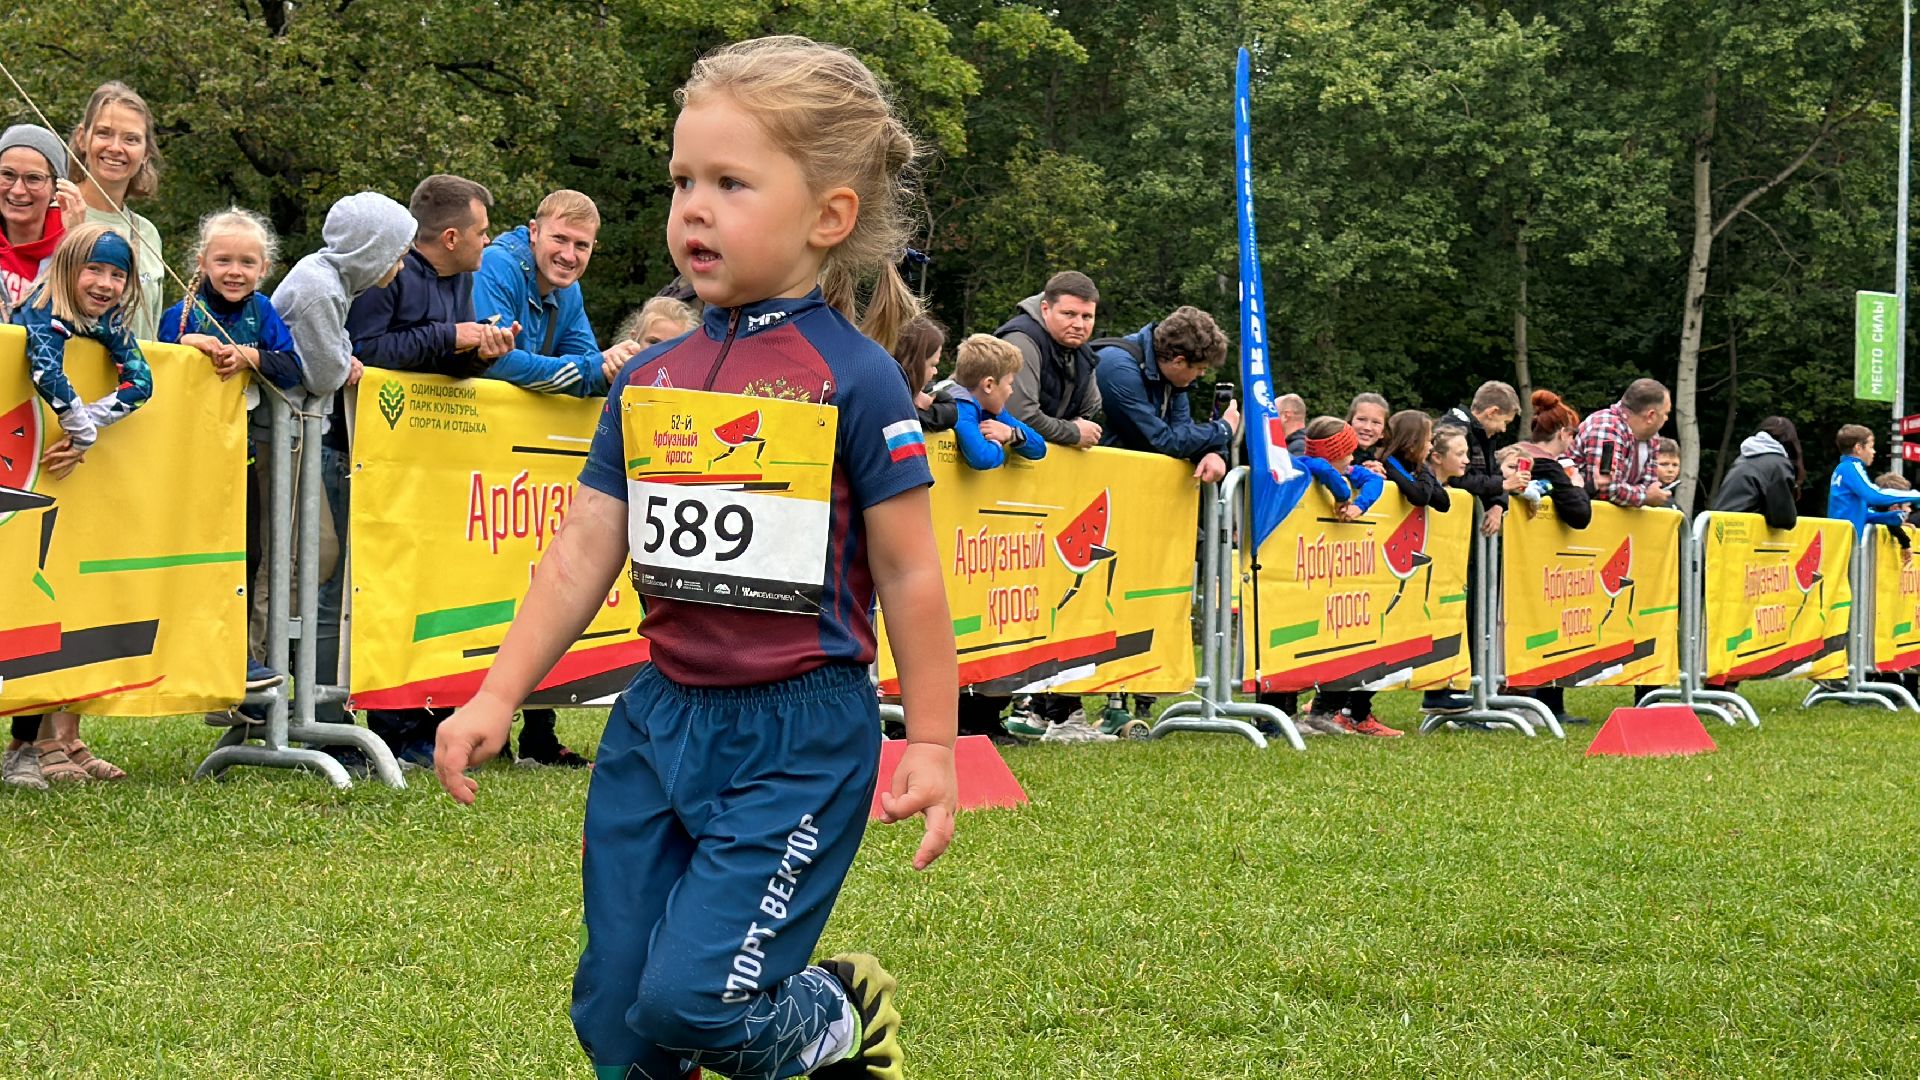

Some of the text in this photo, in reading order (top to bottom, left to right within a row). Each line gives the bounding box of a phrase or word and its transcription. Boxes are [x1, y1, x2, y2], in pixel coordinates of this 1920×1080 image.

[1871, 301, 1885, 395] МЕСТО СИЛЫ
[410, 399, 479, 417] ПАРК КУЛЬТУРЫ,
[411, 383, 477, 400] ОДИНЦОВСКИЙ
[409, 416, 487, 433] СПОРТА И ОТДЫХА
[653, 430, 698, 448] Арбузный
[938, 440, 958, 452] ПАРК
[665, 450, 693, 465] кросс
[466, 469, 572, 554] Арбуз
[643, 495, 754, 561] 589
[954, 521, 1046, 585] Арбузный
[1295, 527, 1376, 591] Арбузный
[1543, 561, 1595, 607] Арбузный
[1743, 554, 1790, 604] Арбузный
[987, 584, 1040, 635] кросс
[1325, 588, 1371, 640] кросс
[1561, 606, 1592, 643] кросс
[1755, 604, 1787, 642] кросс
[759, 813, 820, 920] ВЕКТОР
